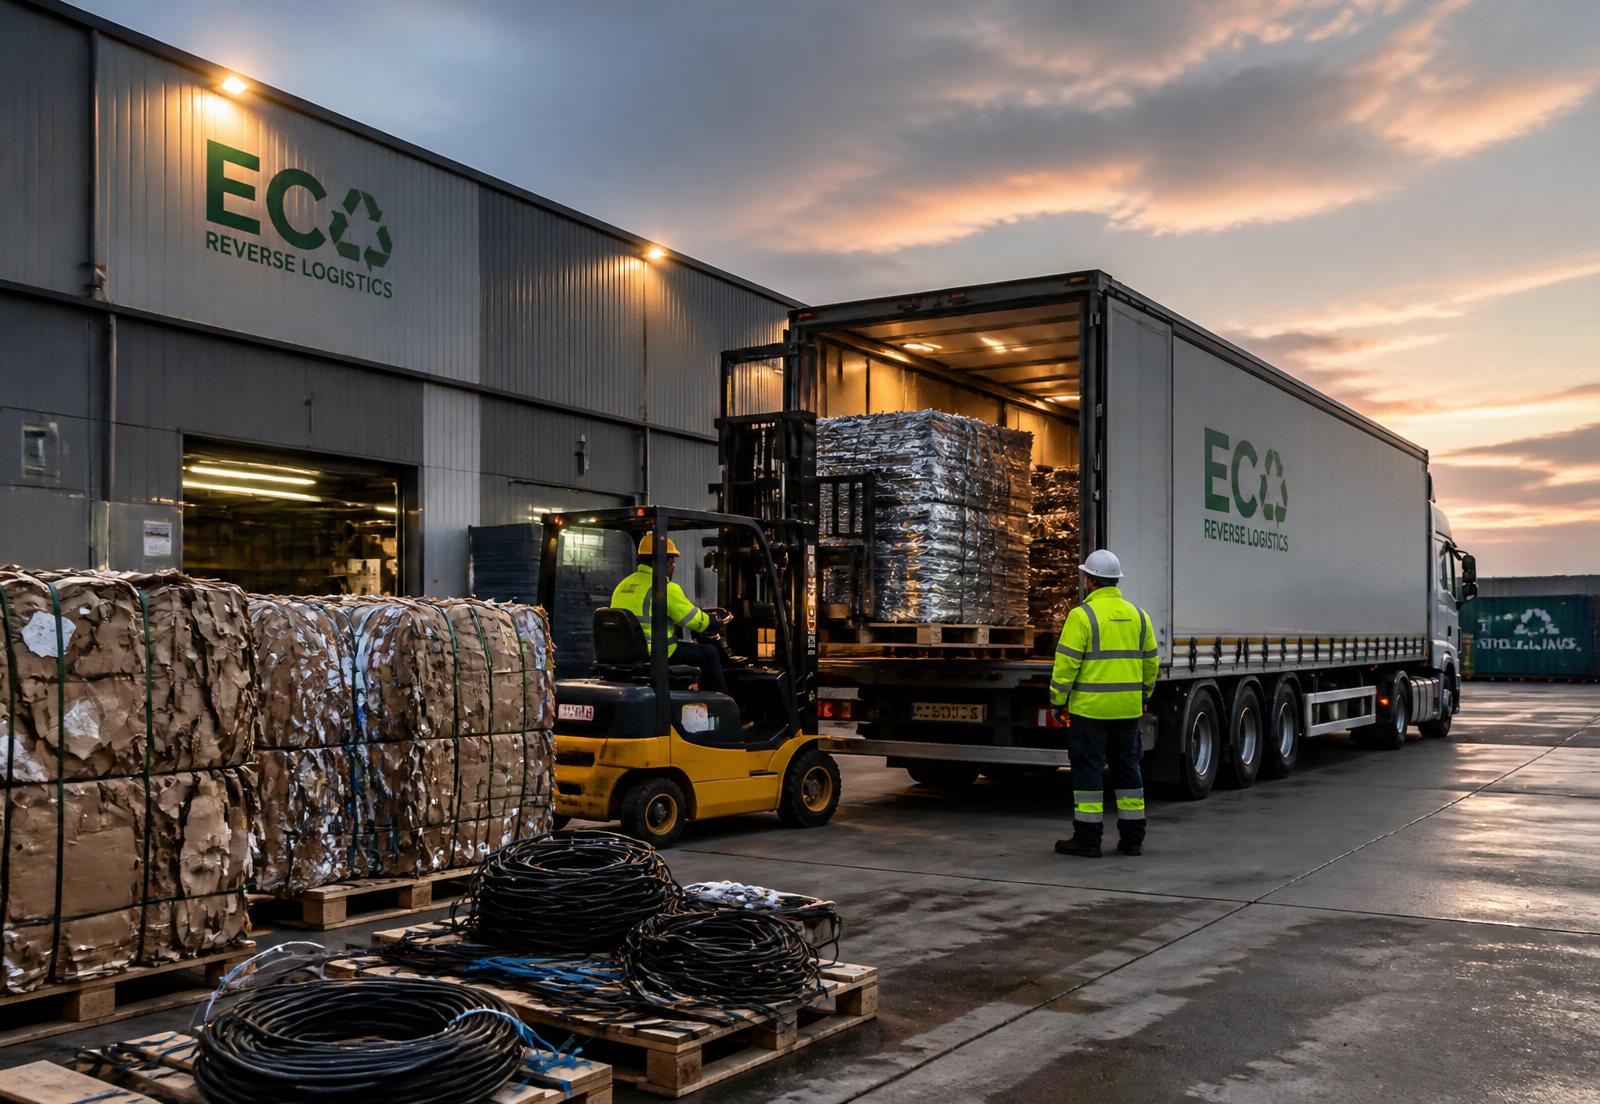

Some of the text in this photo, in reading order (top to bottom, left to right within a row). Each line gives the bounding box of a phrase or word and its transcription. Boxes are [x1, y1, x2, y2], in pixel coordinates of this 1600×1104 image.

[206, 230, 392, 299] REVERSE LOGISTICS
[1204, 518, 1289, 552] REVERSE LOGISTICS
